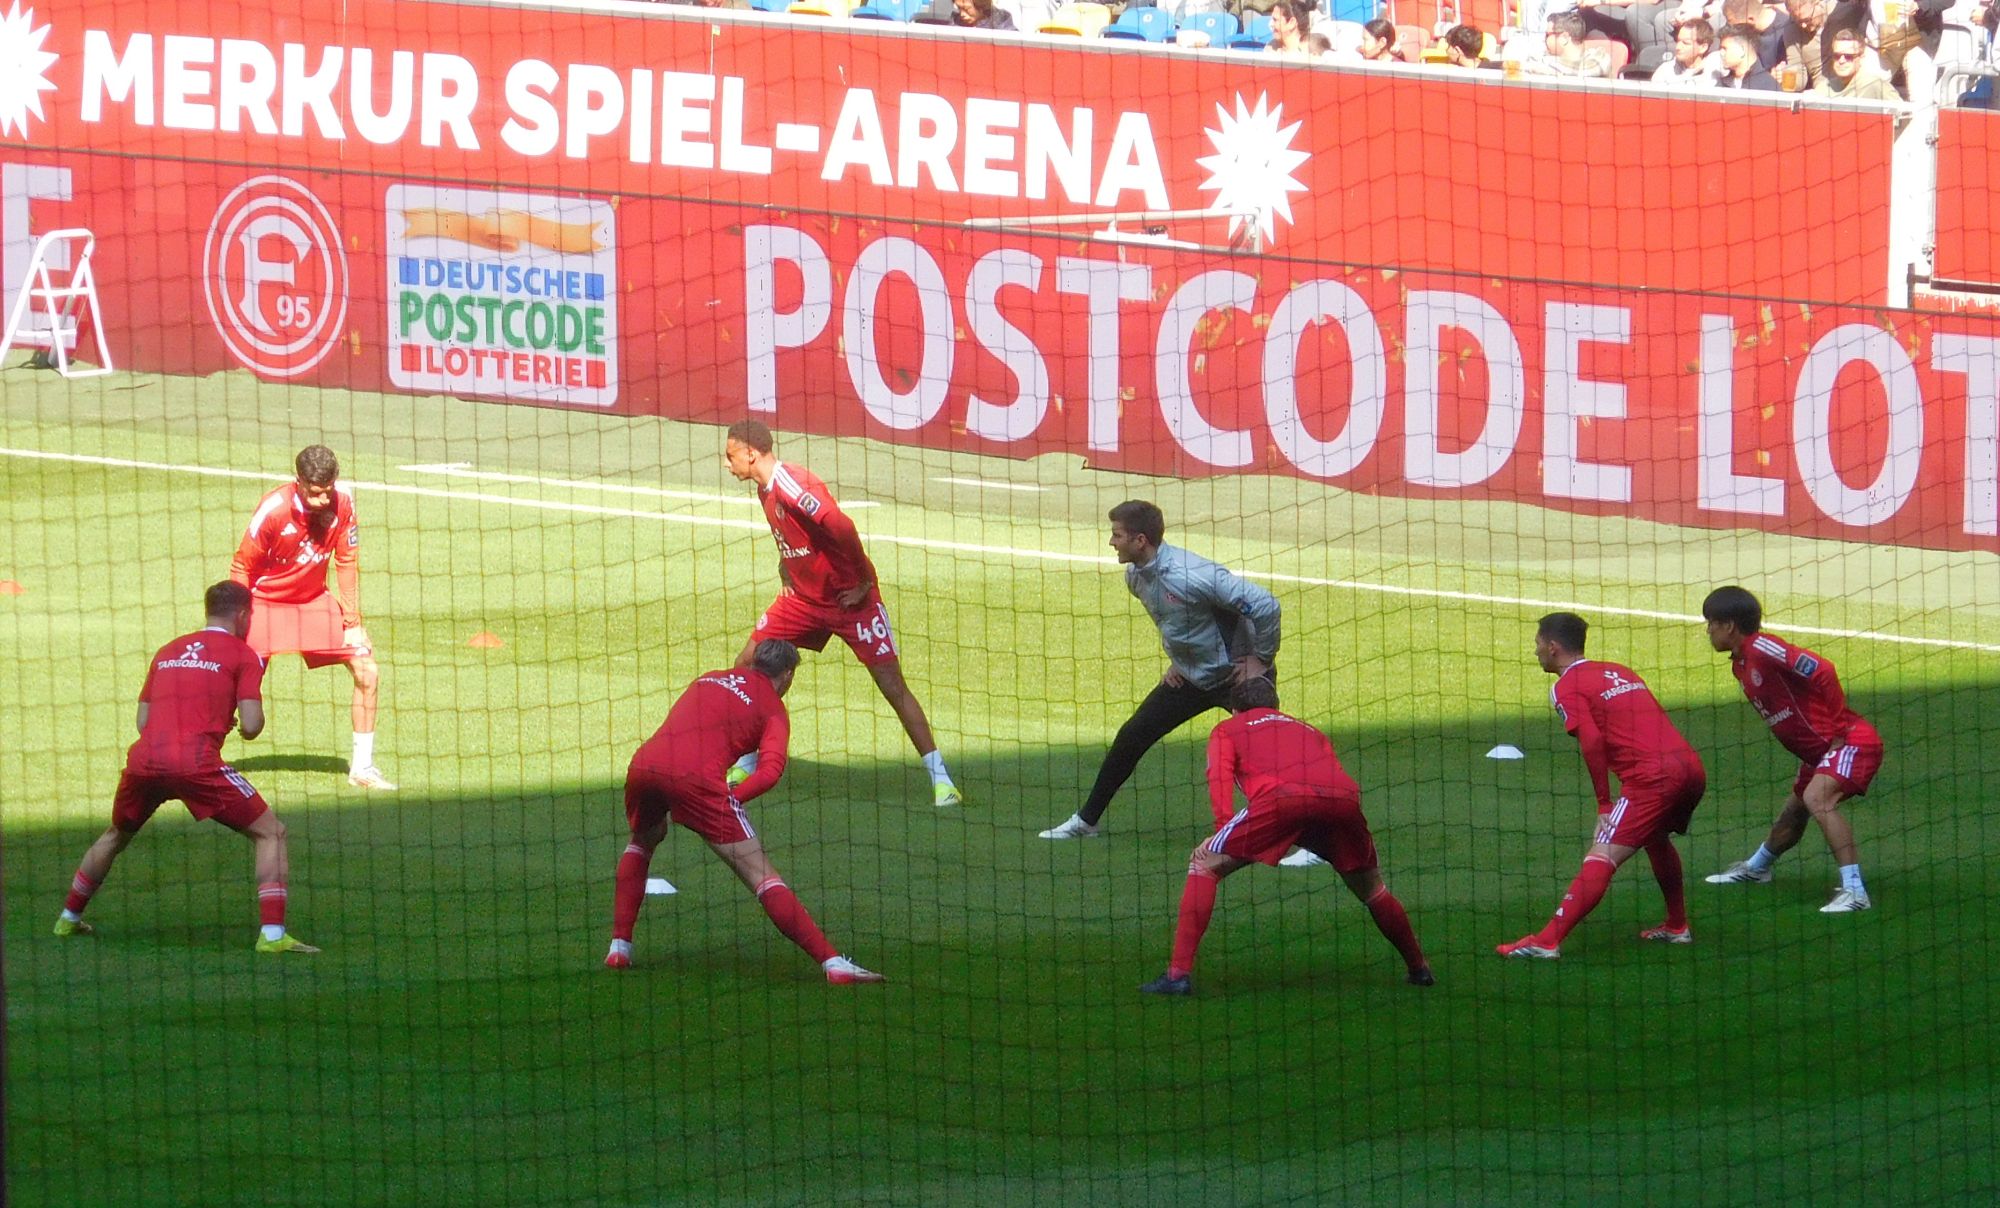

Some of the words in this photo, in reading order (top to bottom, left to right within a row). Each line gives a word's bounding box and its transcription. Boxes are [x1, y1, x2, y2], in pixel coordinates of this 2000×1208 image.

[80, 30, 482, 151] MERKUR
[500, 58, 1170, 211] SPIEL-ARENA
[424, 260, 581, 298] DEUTSCHE
[276, 295, 313, 329] 95
[401, 292, 605, 354] POSTCODE
[426, 346, 584, 387] LOTTERIE
[744, 224, 1632, 505] POSTCODE
[1697, 313, 2000, 536] LOT
[856, 615, 887, 644] 46
[158, 660, 220, 672] TARGOBANK
